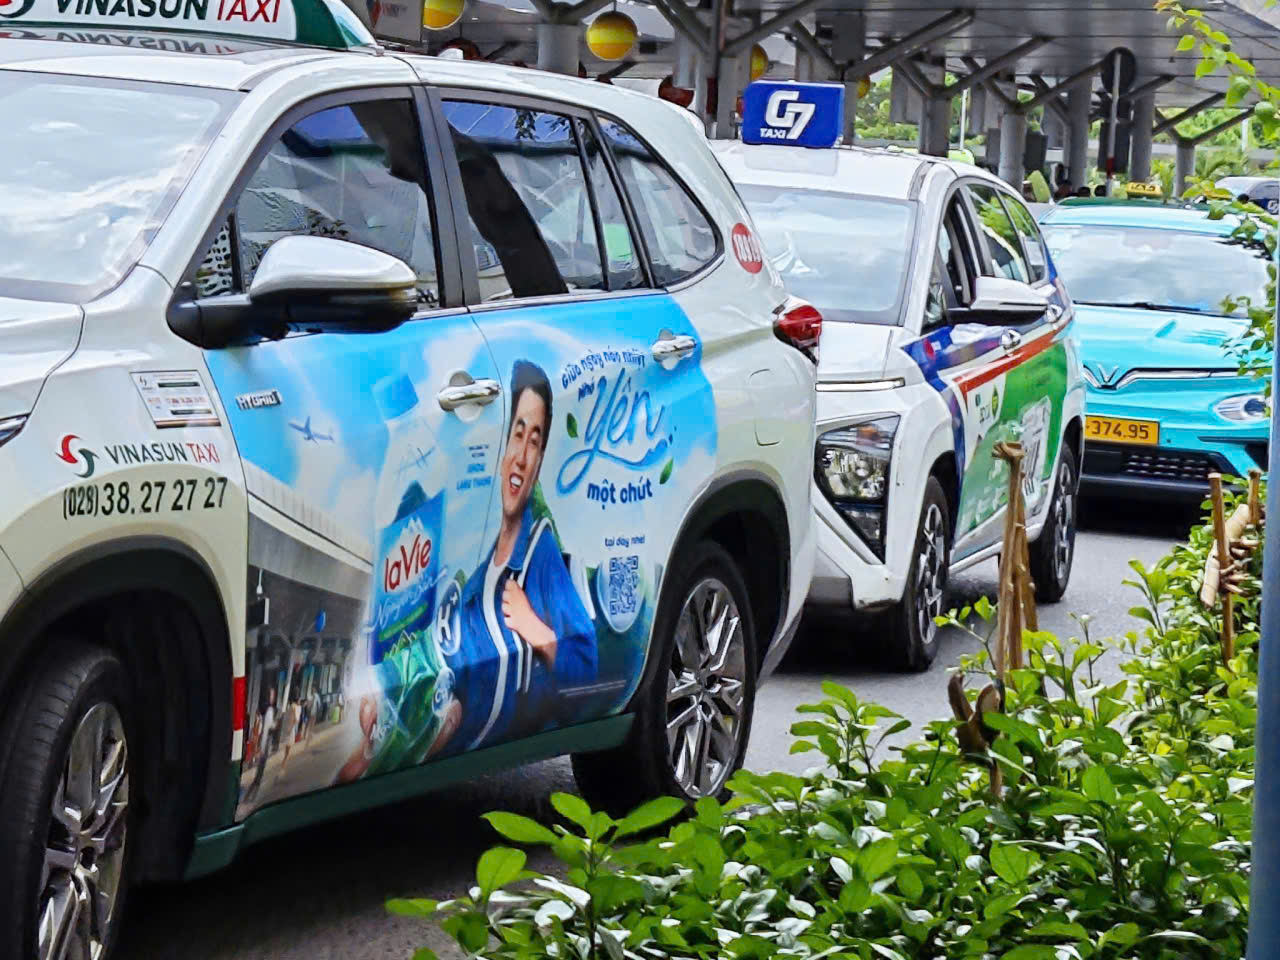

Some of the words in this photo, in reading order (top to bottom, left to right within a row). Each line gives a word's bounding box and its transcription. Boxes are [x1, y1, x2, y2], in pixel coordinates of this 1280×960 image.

[765, 90, 816, 140] G7
[760, 128, 786, 140] TAXI
[1085, 420, 1150, 440] -374.95
[105, 442, 187, 464] VINASUN
[186, 442, 220, 463] TAXI
[587, 478, 616, 511] một
[620, 475, 653, 504] chút
